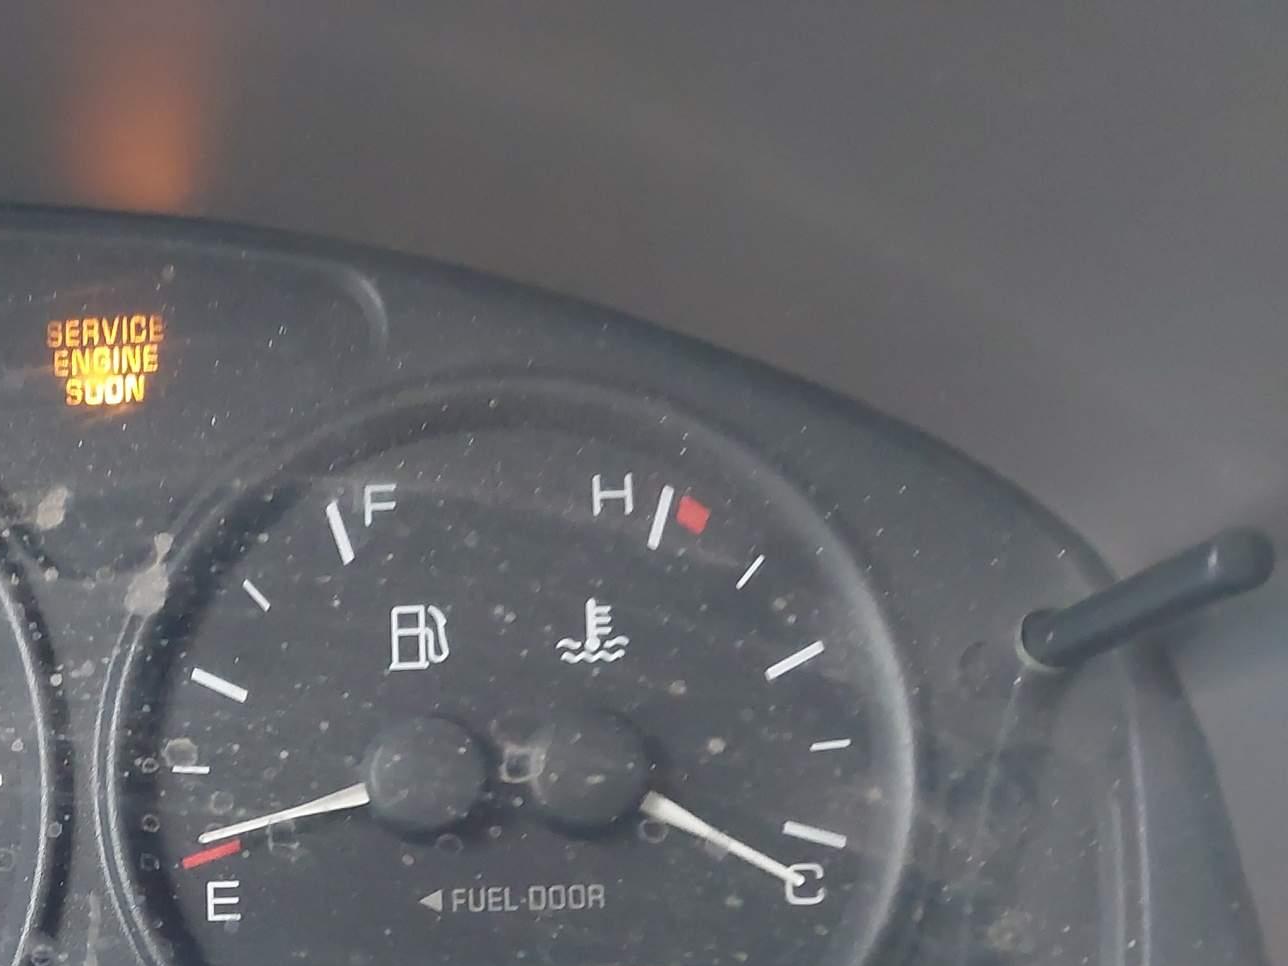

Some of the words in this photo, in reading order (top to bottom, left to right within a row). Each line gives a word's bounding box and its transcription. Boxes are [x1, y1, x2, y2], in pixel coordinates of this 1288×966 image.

[47, 314, 164, 348] SERVICE
[54, 344, 159, 377] ENGINE
[66, 373, 146, 406] SOON
[364, 483, 397, 526] F
[592, 473, 633, 516] H
[207, 881, 241, 921] E
[452, 888, 519, 912] FUEL
[528, 884, 605, 911] DOOR
[785, 863, 825, 905] C
